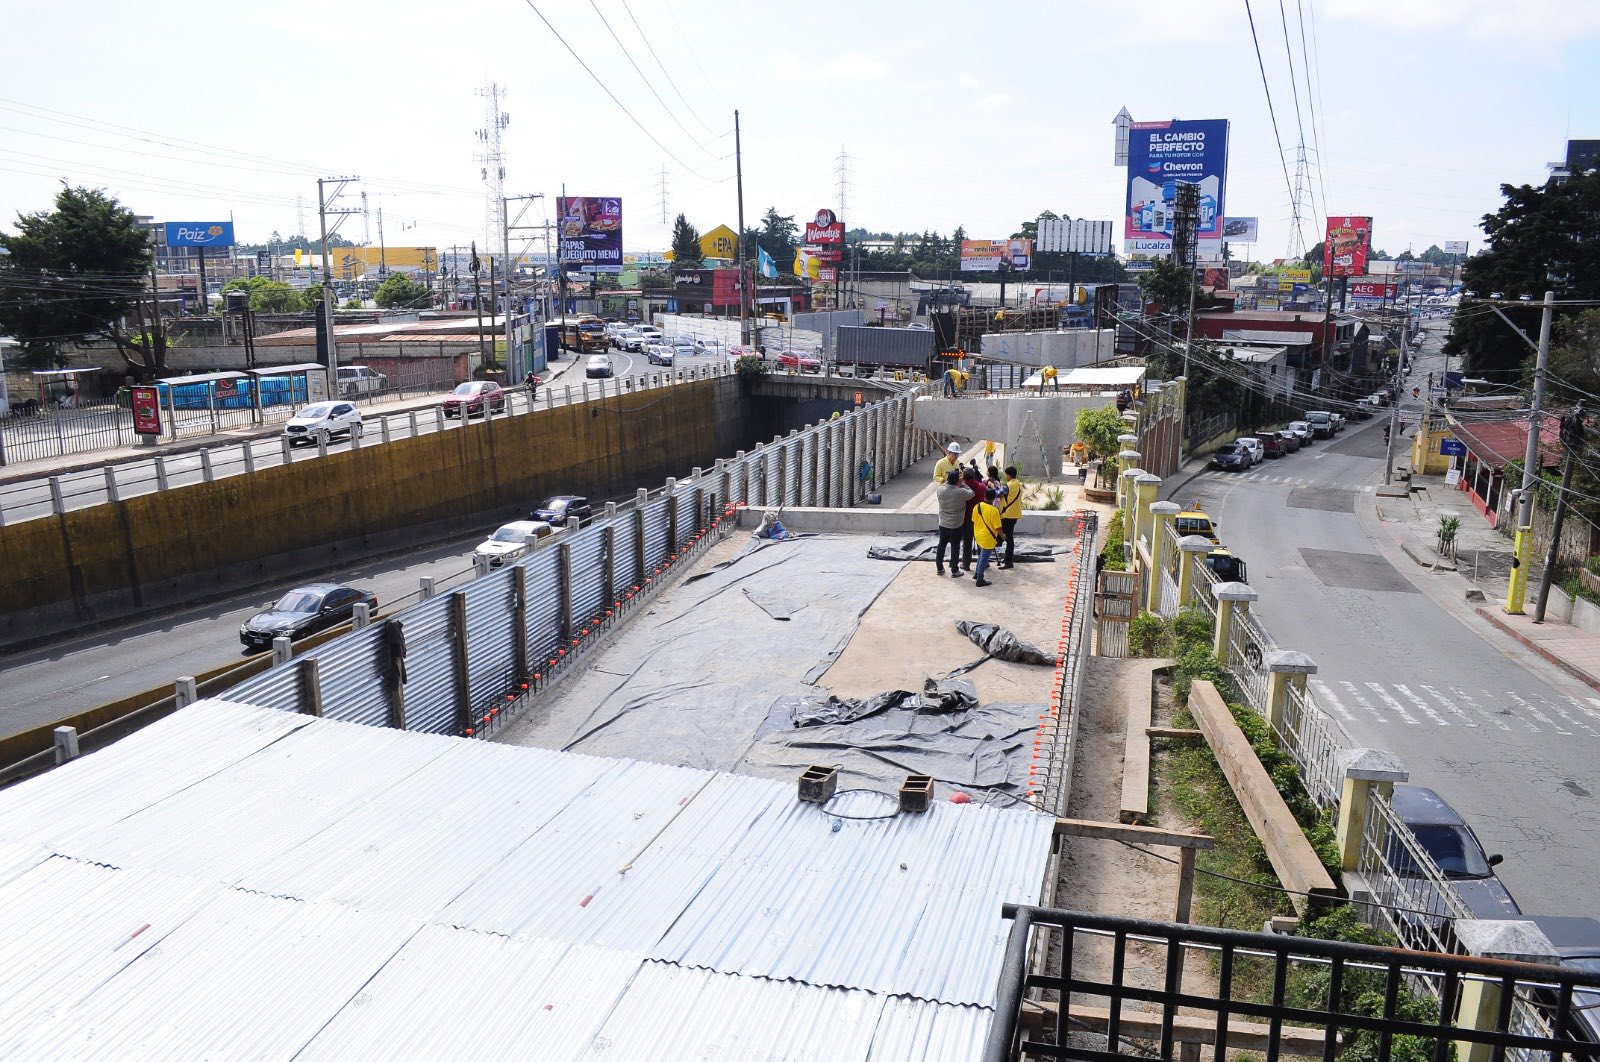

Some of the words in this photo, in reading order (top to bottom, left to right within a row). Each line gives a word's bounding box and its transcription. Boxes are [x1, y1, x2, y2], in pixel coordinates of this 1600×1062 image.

[1150, 134, 1162, 142] EL
[1164, 132, 1205, 142] CAMBIO
[1149, 142, 1205, 152] PERFECTO
[1163, 162, 1203, 171] Chevron
[177, 228, 205, 240] Paiz
[807, 226, 840, 242] Wendy's
[717, 237, 732, 253] EPA
[1135, 241, 1170, 250] Lucalza
[597, 248, 619, 259] MENÚ
[1354, 285, 1374, 293] AEC
